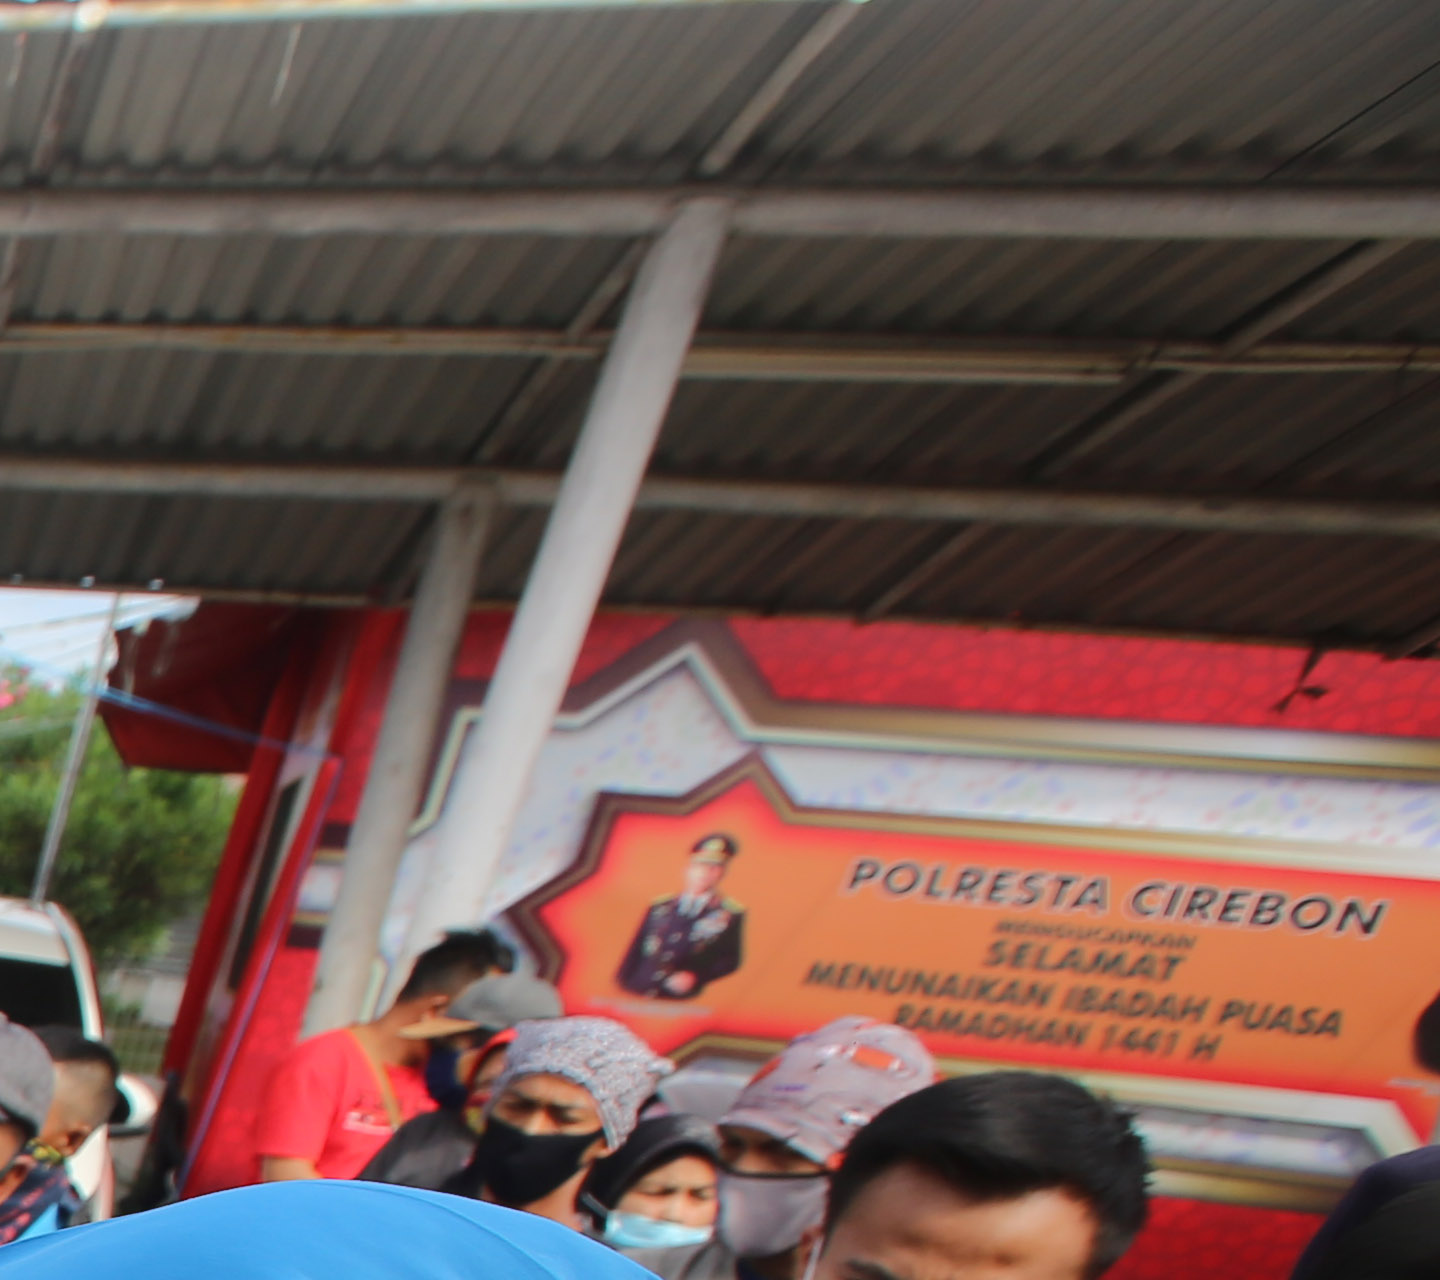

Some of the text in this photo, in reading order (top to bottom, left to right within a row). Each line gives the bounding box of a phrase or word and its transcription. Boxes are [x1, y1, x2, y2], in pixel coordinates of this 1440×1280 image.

[845, 858, 1386, 936] POLRESTA CIREBON
[987, 938, 1188, 983] SELAMAT
[805, 960, 1344, 1038] MENUNAIKAN IBADAH PUASA
[894, 1003, 1224, 1062] RAMADHAN 1441 H
